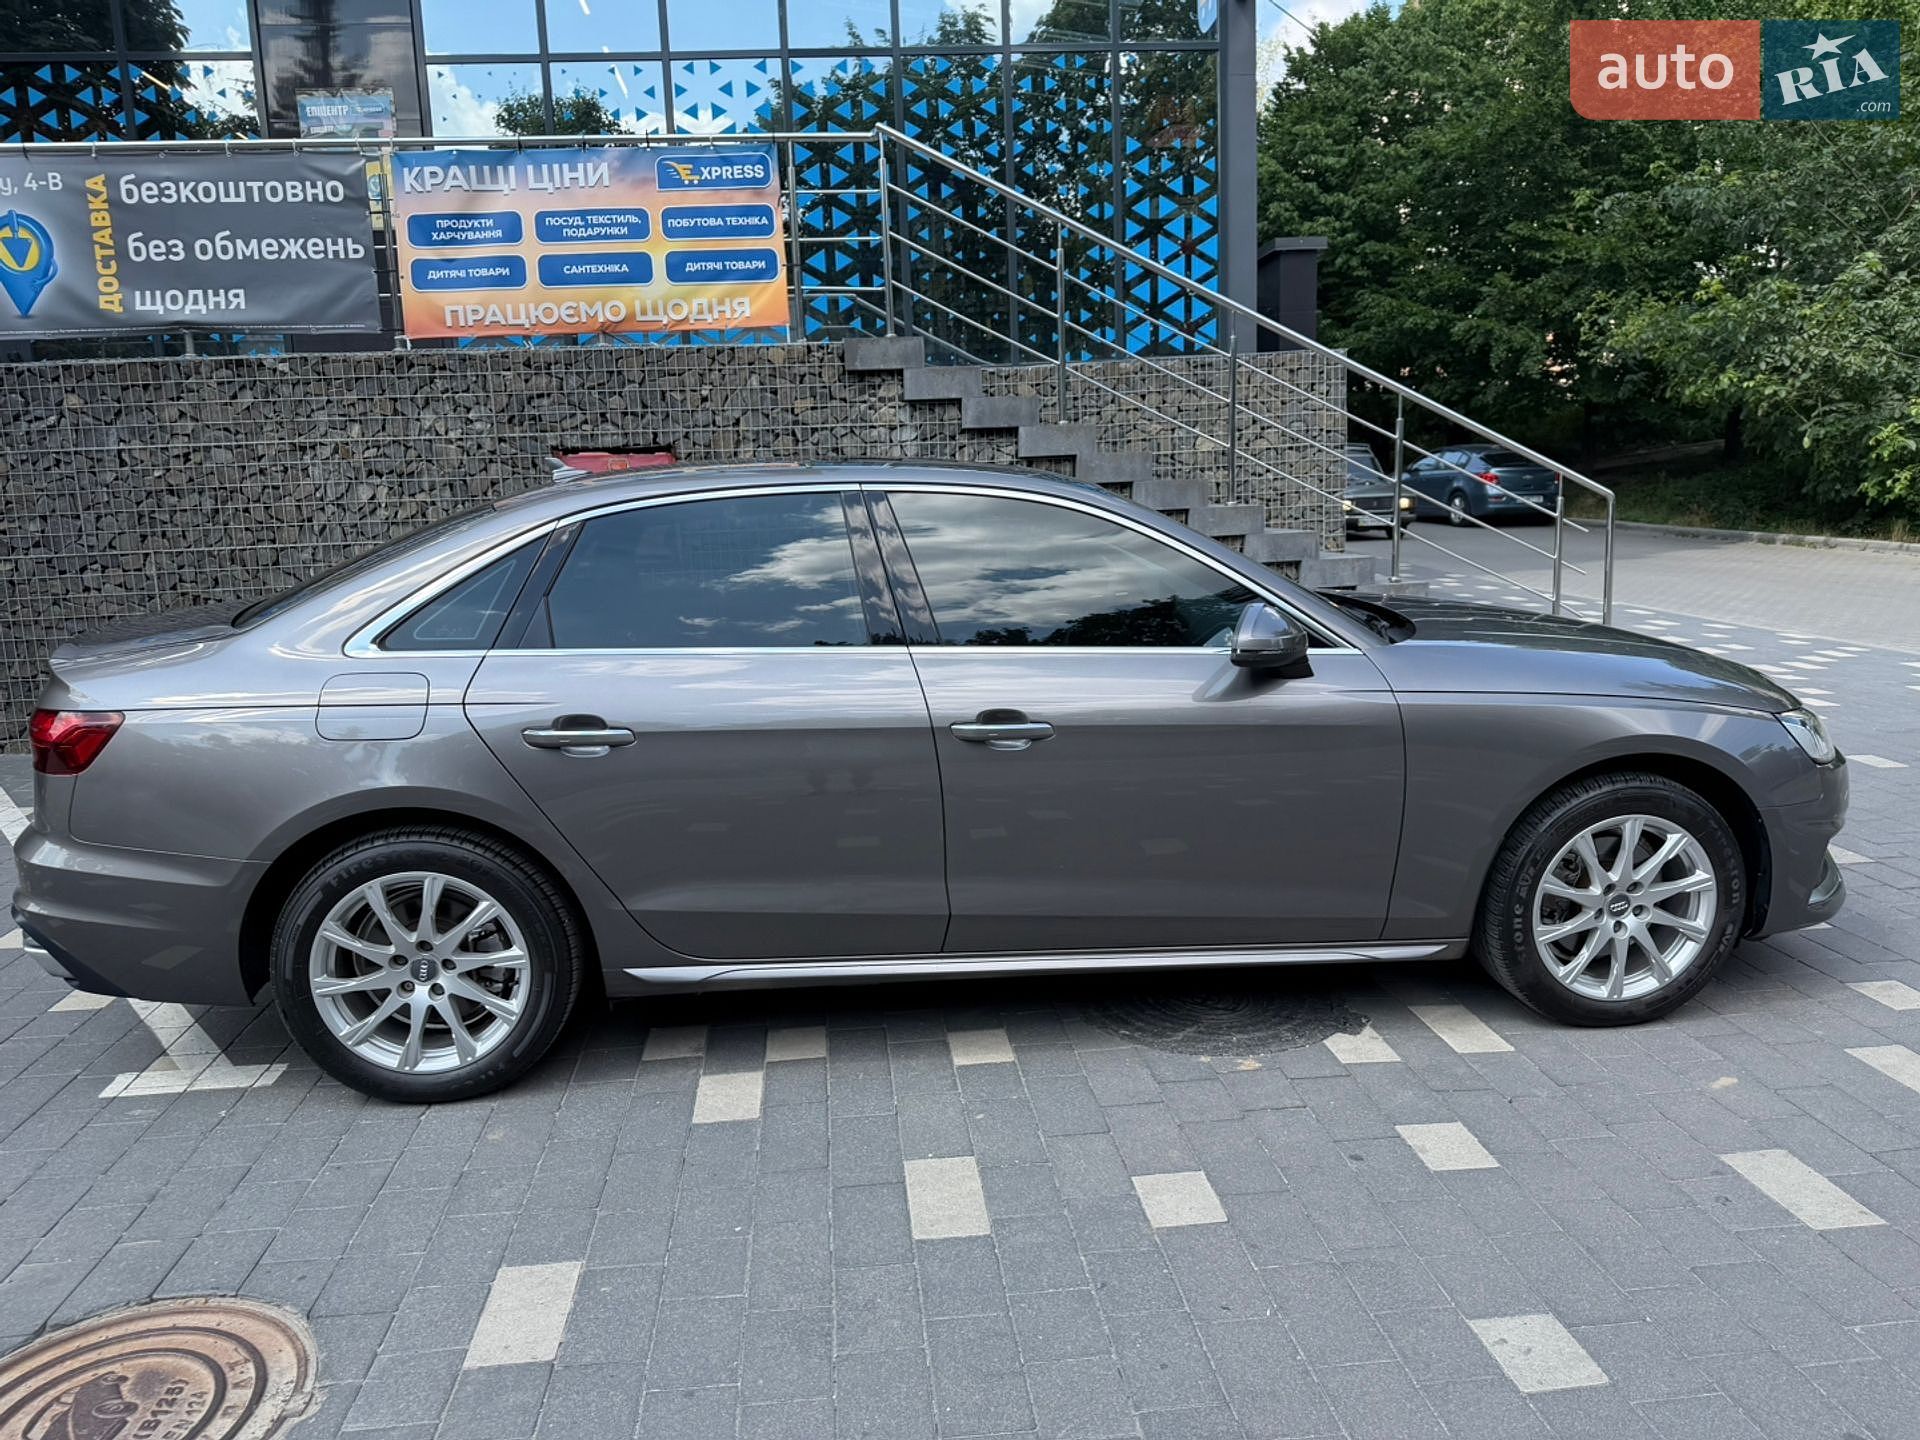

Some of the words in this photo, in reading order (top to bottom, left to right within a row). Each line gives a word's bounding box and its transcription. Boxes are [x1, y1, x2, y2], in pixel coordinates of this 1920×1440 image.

[402, 164, 517, 195] КРАЩІ
[527, 162, 611, 194] ЦІНИ
[672, 162, 765, 184] EXPRESS
[119, 173, 345, 204] безкоштовно
[435, 219, 494, 230] ПРОДУКТИ
[545, 216, 585, 226] ПОСУД,
[586, 214, 642, 225] ТЕКСТИЛЬ,
[667, 218, 724, 228] ПОБУТОВА
[725, 216, 769, 226] ТЕХНІКА
[431, 230, 503, 240] ХАРЧУВАННЯ
[562, 226, 628, 238] ПОДАРУНКИ
[84, 173, 124, 313] ДОСТАВКА
[127, 231, 185, 262] без
[194, 230, 366, 261] обмежень
[563, 264, 630, 275] САНТЕХНІКА
[685, 261, 723, 273] ДИТЯЧІ
[724, 260, 767, 270] ТОВАРИ
[427, 270, 467, 280] ДИТЯЧІ
[468, 267, 510, 278] ТОВАРИ
[134, 288, 246, 314] щодня
[444, 300, 627, 329] ПРАЦЮЄМО
[634, 296, 752, 326] ЩОДНЯ
